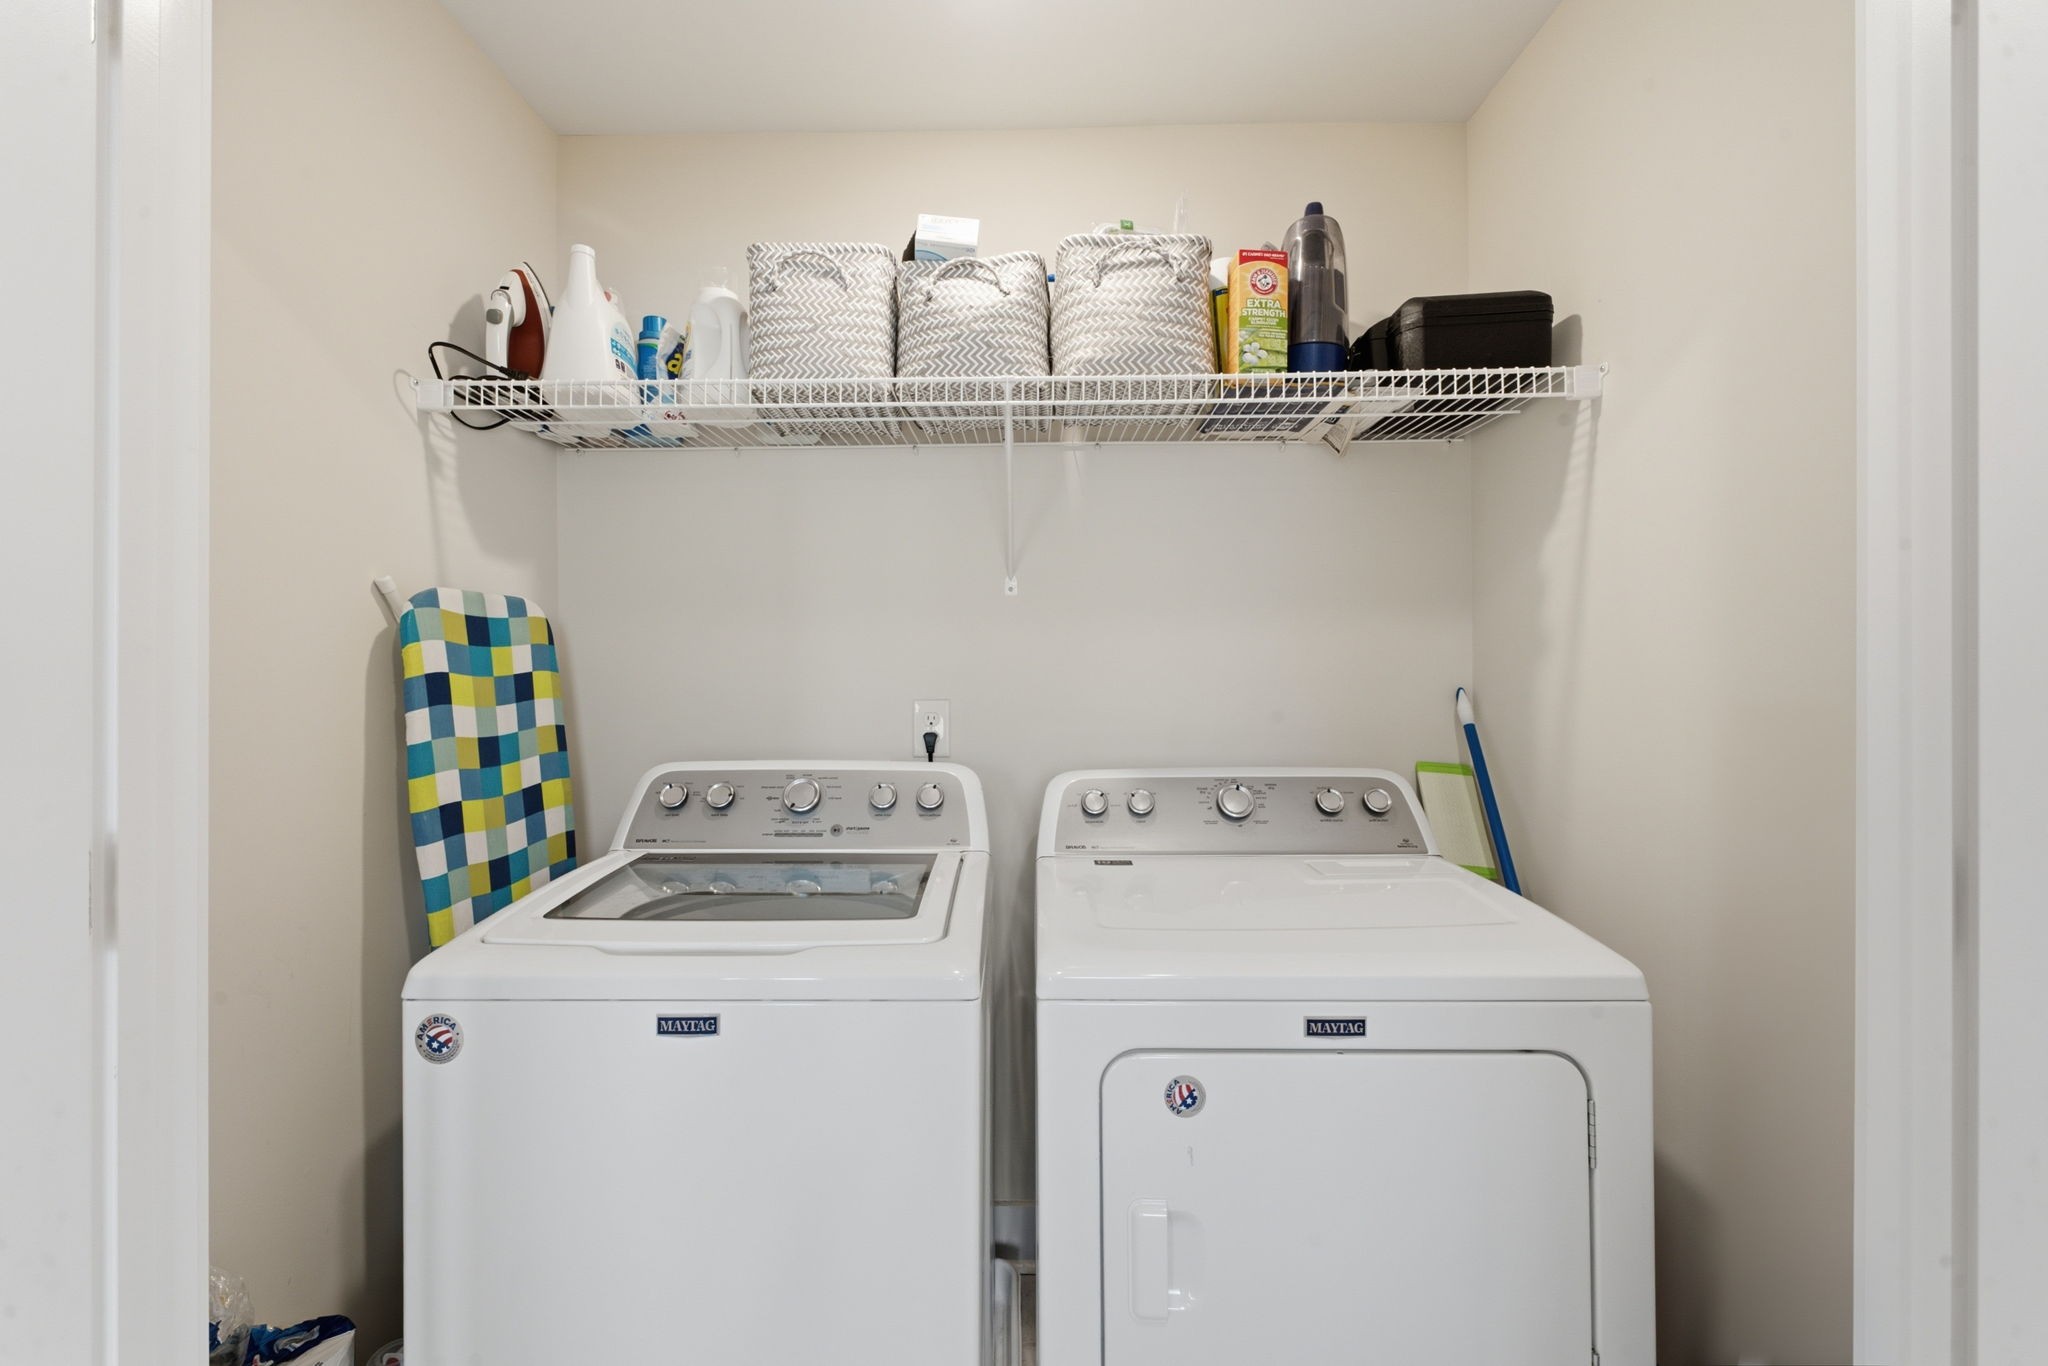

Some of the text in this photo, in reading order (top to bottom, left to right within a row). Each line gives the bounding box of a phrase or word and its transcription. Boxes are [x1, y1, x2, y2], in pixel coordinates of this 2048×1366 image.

[1247, 299, 1281, 309] EXTRA
[1242, 308, 1286, 318] STRENGTH
[416, 1016, 457, 1041] AMERICA
[660, 1019, 716, 1032] MAYTAG
[1308, 1022, 1364, 1034] MAYTAG
